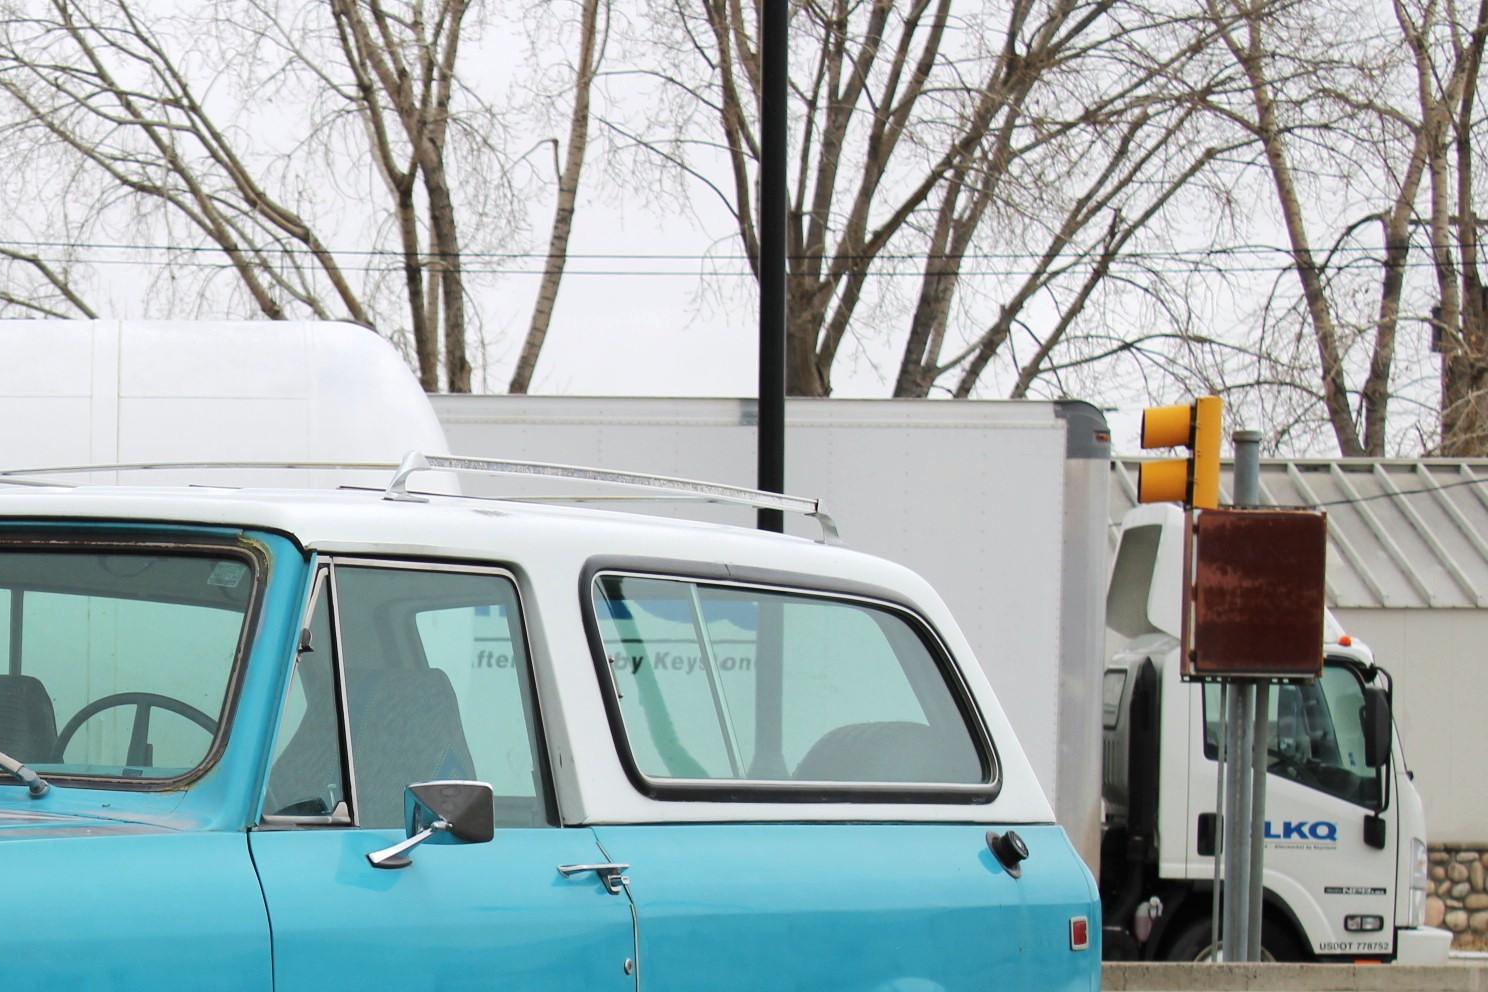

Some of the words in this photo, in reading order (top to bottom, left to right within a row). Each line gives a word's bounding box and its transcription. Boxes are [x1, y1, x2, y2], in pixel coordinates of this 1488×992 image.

[613, 652, 643, 674] by
[1263, 821, 1337, 842] LKQ
[1319, 942, 1353, 951] USDOT
